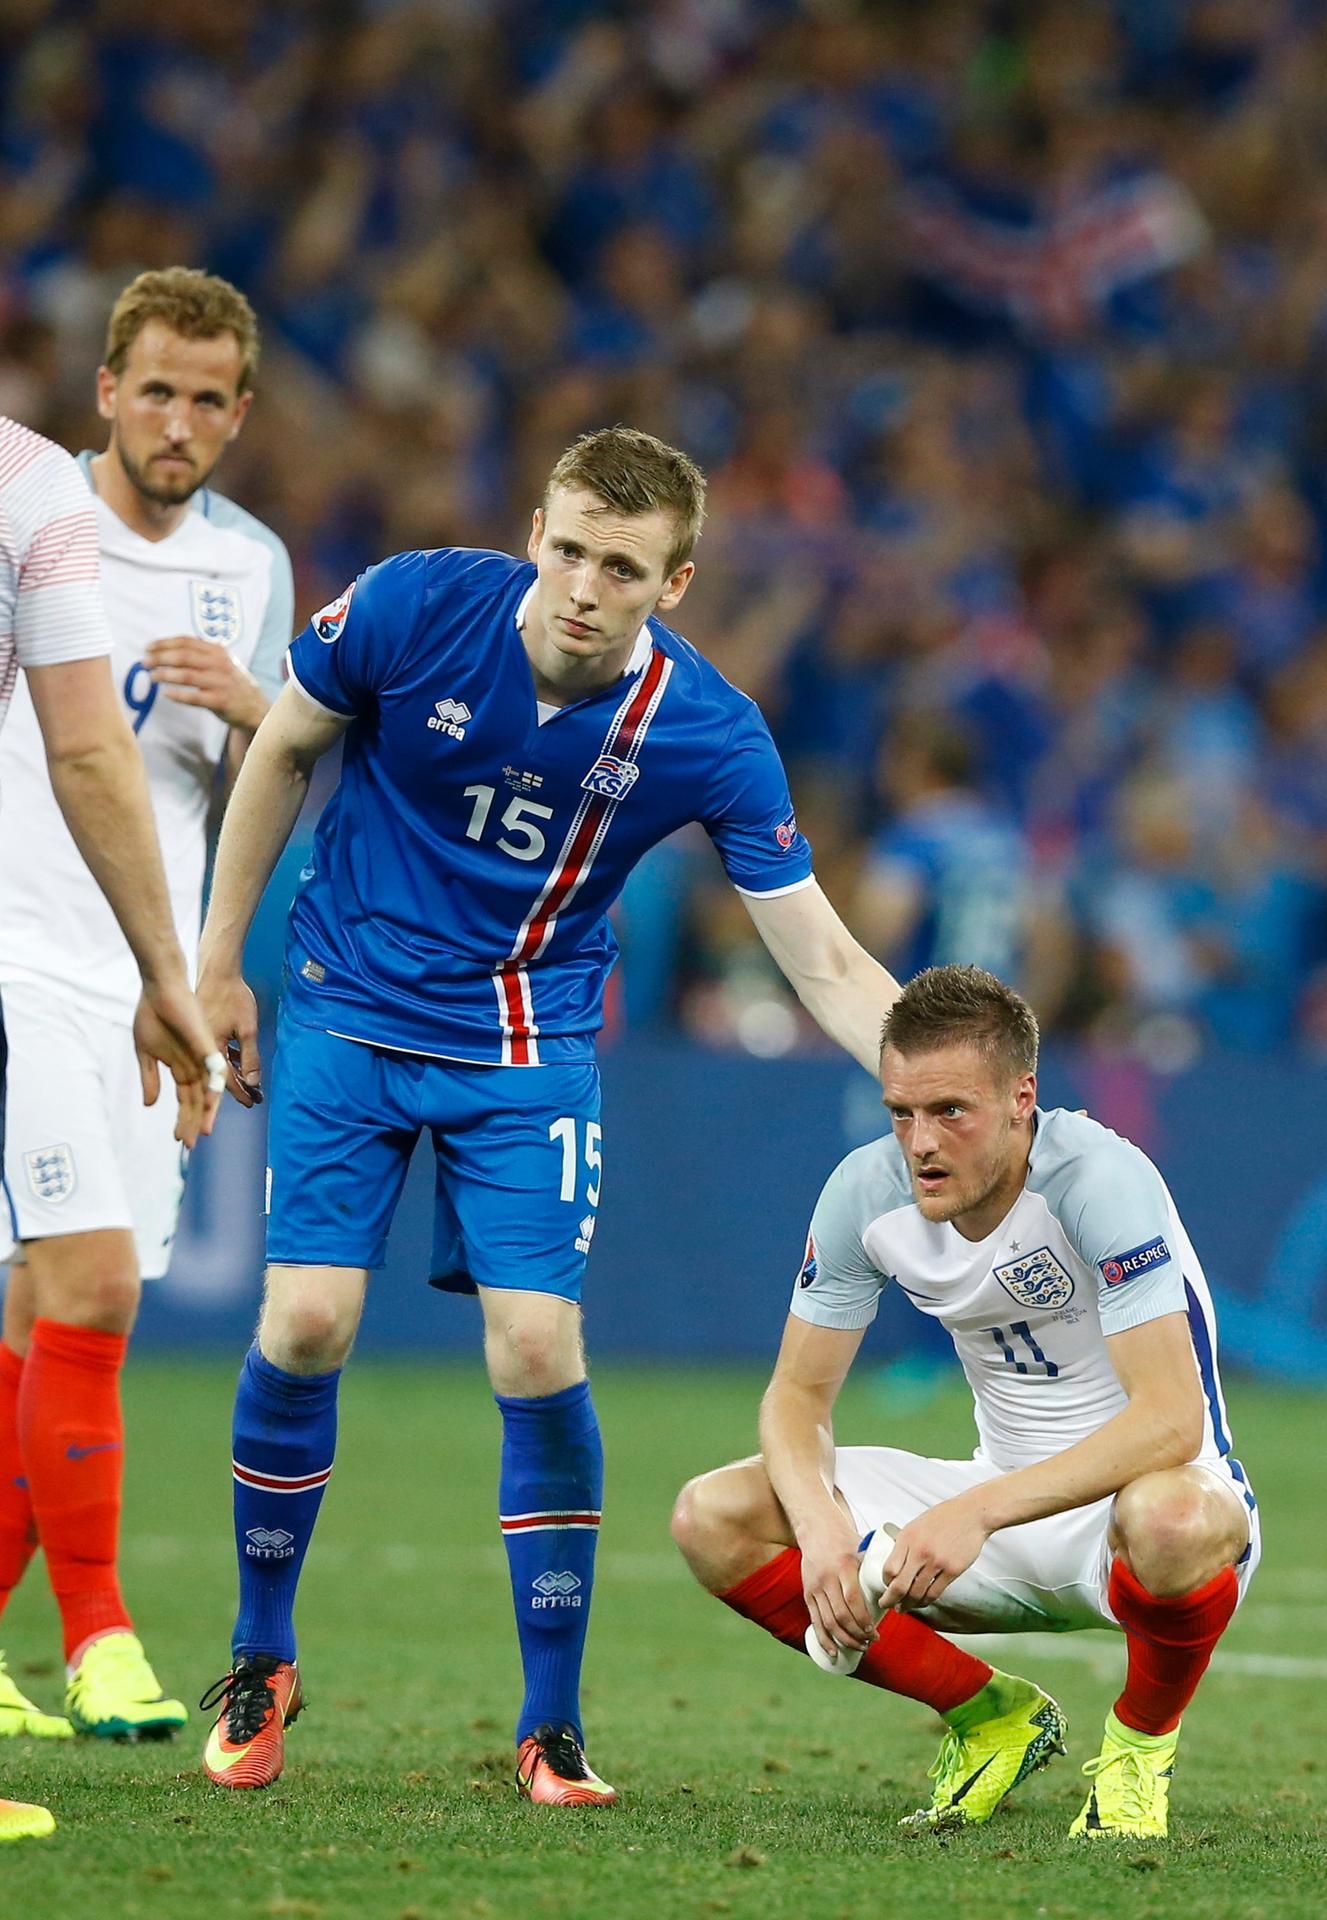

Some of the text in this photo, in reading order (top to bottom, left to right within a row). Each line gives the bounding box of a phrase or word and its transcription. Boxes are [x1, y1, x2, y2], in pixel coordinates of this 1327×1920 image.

[427, 716, 466, 741] errea
[463, 784, 554, 861] 15
[549, 1117, 602, 1208] 15
[1122, 1242, 1168, 1274] RESPECT
[979, 1320, 1058, 1377] 11
[531, 1595, 582, 1609] errea
